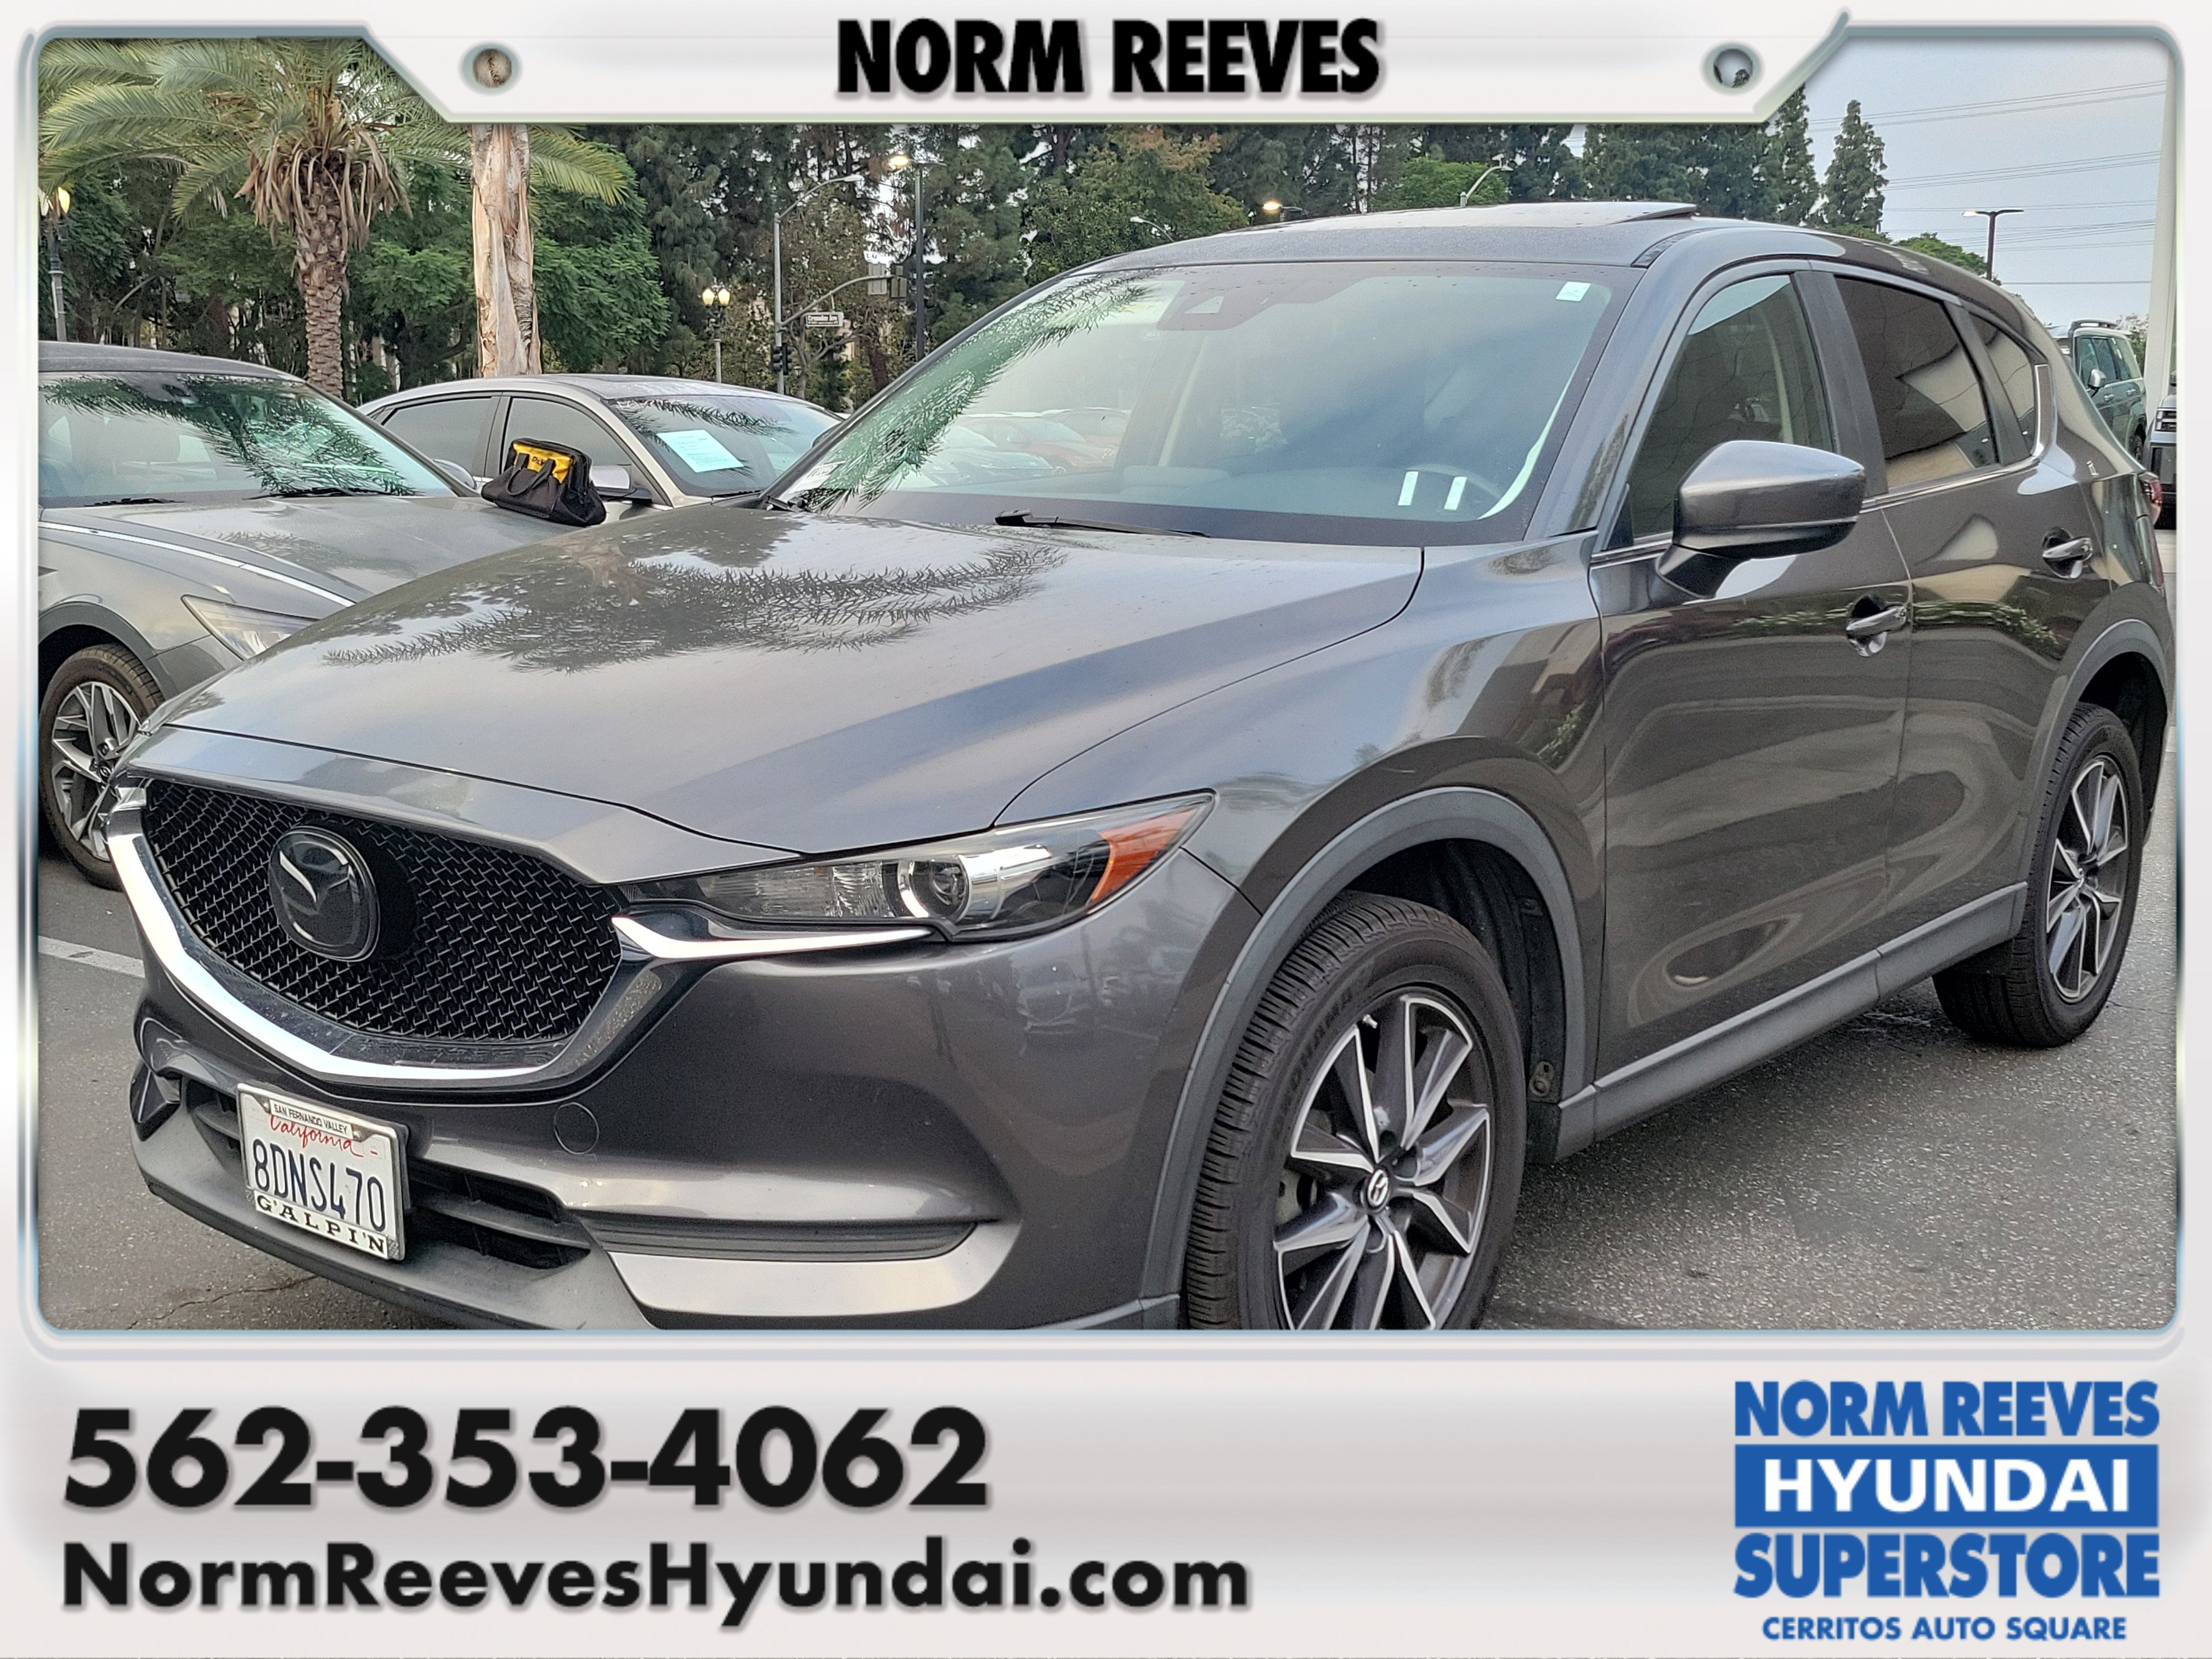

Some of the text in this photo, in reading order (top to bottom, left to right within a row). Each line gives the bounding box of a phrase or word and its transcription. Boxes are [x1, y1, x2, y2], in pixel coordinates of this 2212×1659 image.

[270, 1115, 364, 1158] California
[274, 1104, 348, 1134] SAN FERNANDO VALLEY
[253, 1138, 386, 1232] 8DNS470
[257, 1195, 384, 1254] GALPIN
